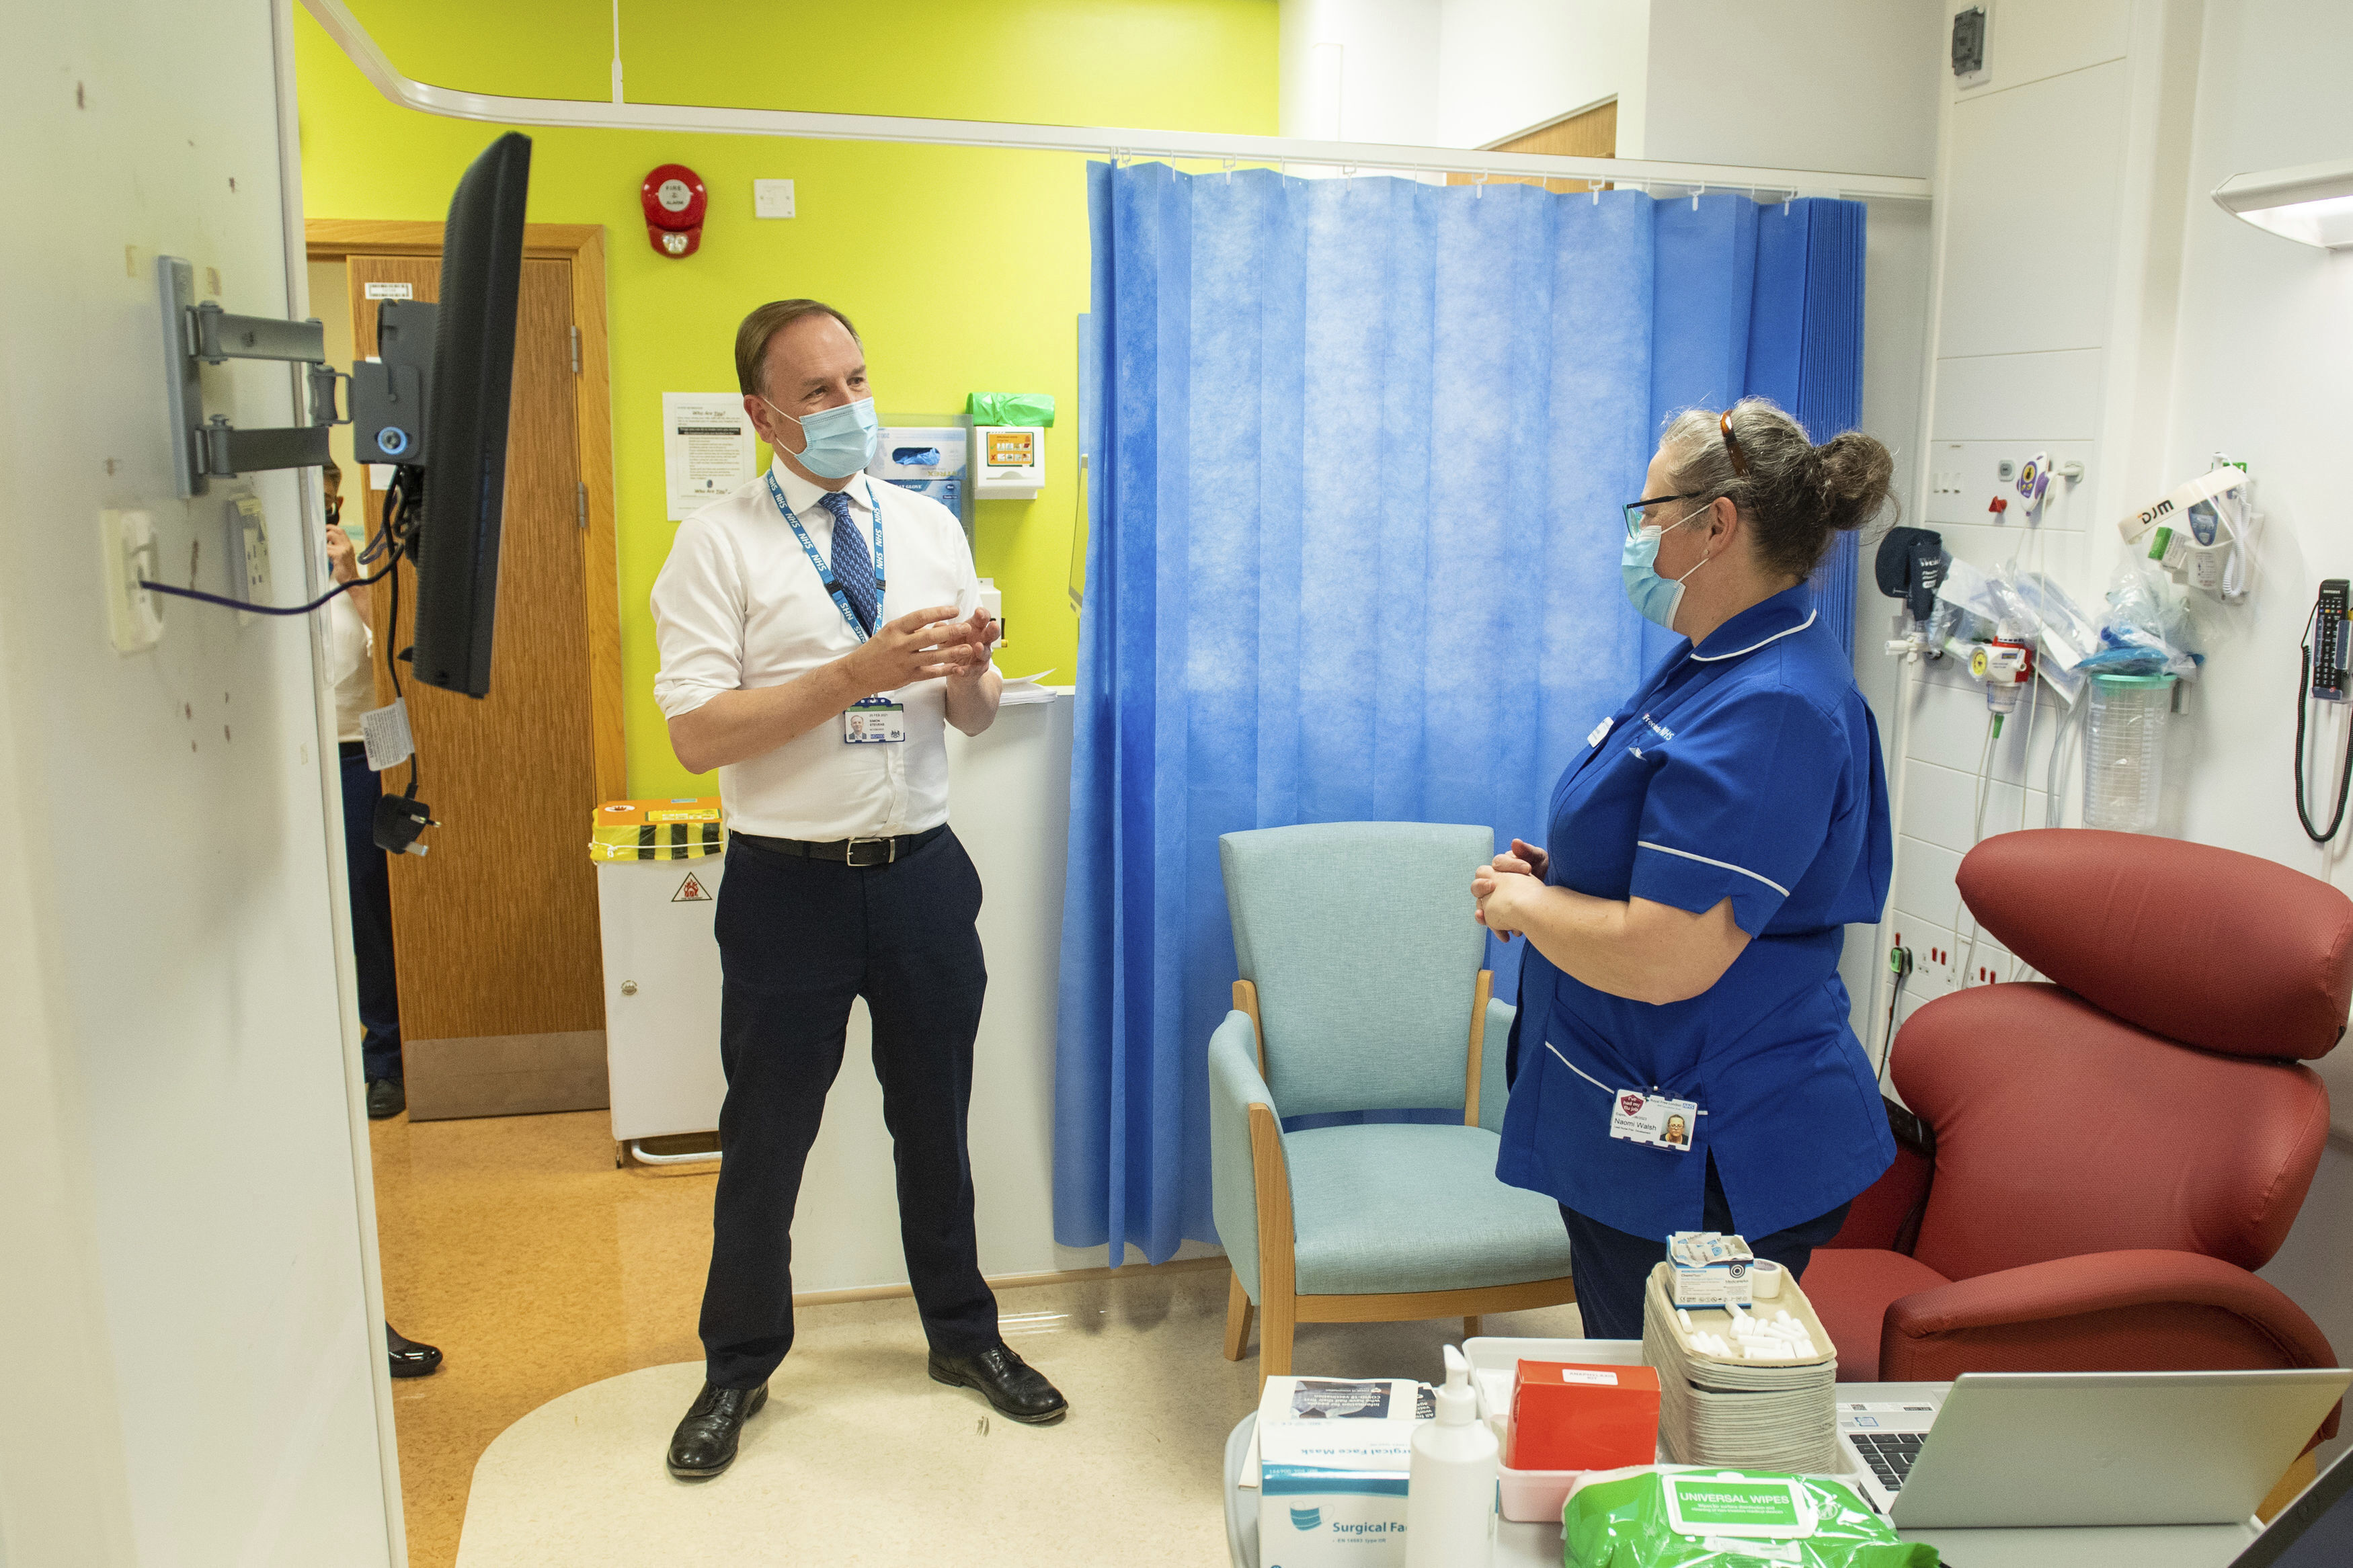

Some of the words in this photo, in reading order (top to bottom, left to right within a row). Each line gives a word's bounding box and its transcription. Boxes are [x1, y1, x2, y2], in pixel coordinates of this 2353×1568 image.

[775, 493, 788, 509] NHS
[785, 512, 800, 529] NHS
[873, 507, 882, 524] NHS
[798, 532, 813, 550] NHS
[811, 554, 827, 571] NHS
[876, 551, 884, 570] NHS
[840, 602, 854, 621] NHS
[853, 626, 866, 644] NHS
[1659, 726, 1675, 741] NHS
[1614, 1118, 1635, 1127] Naomi
[1636, 1122, 1657, 1131] Walsh
[1679, 1492, 1748, 1504] UNIVERSAL
[1749, 1494, 1790, 1505] WIPES
[1333, 1522, 1386, 1535] Surgical
[1390, 1522, 1407, 1532] Fa
